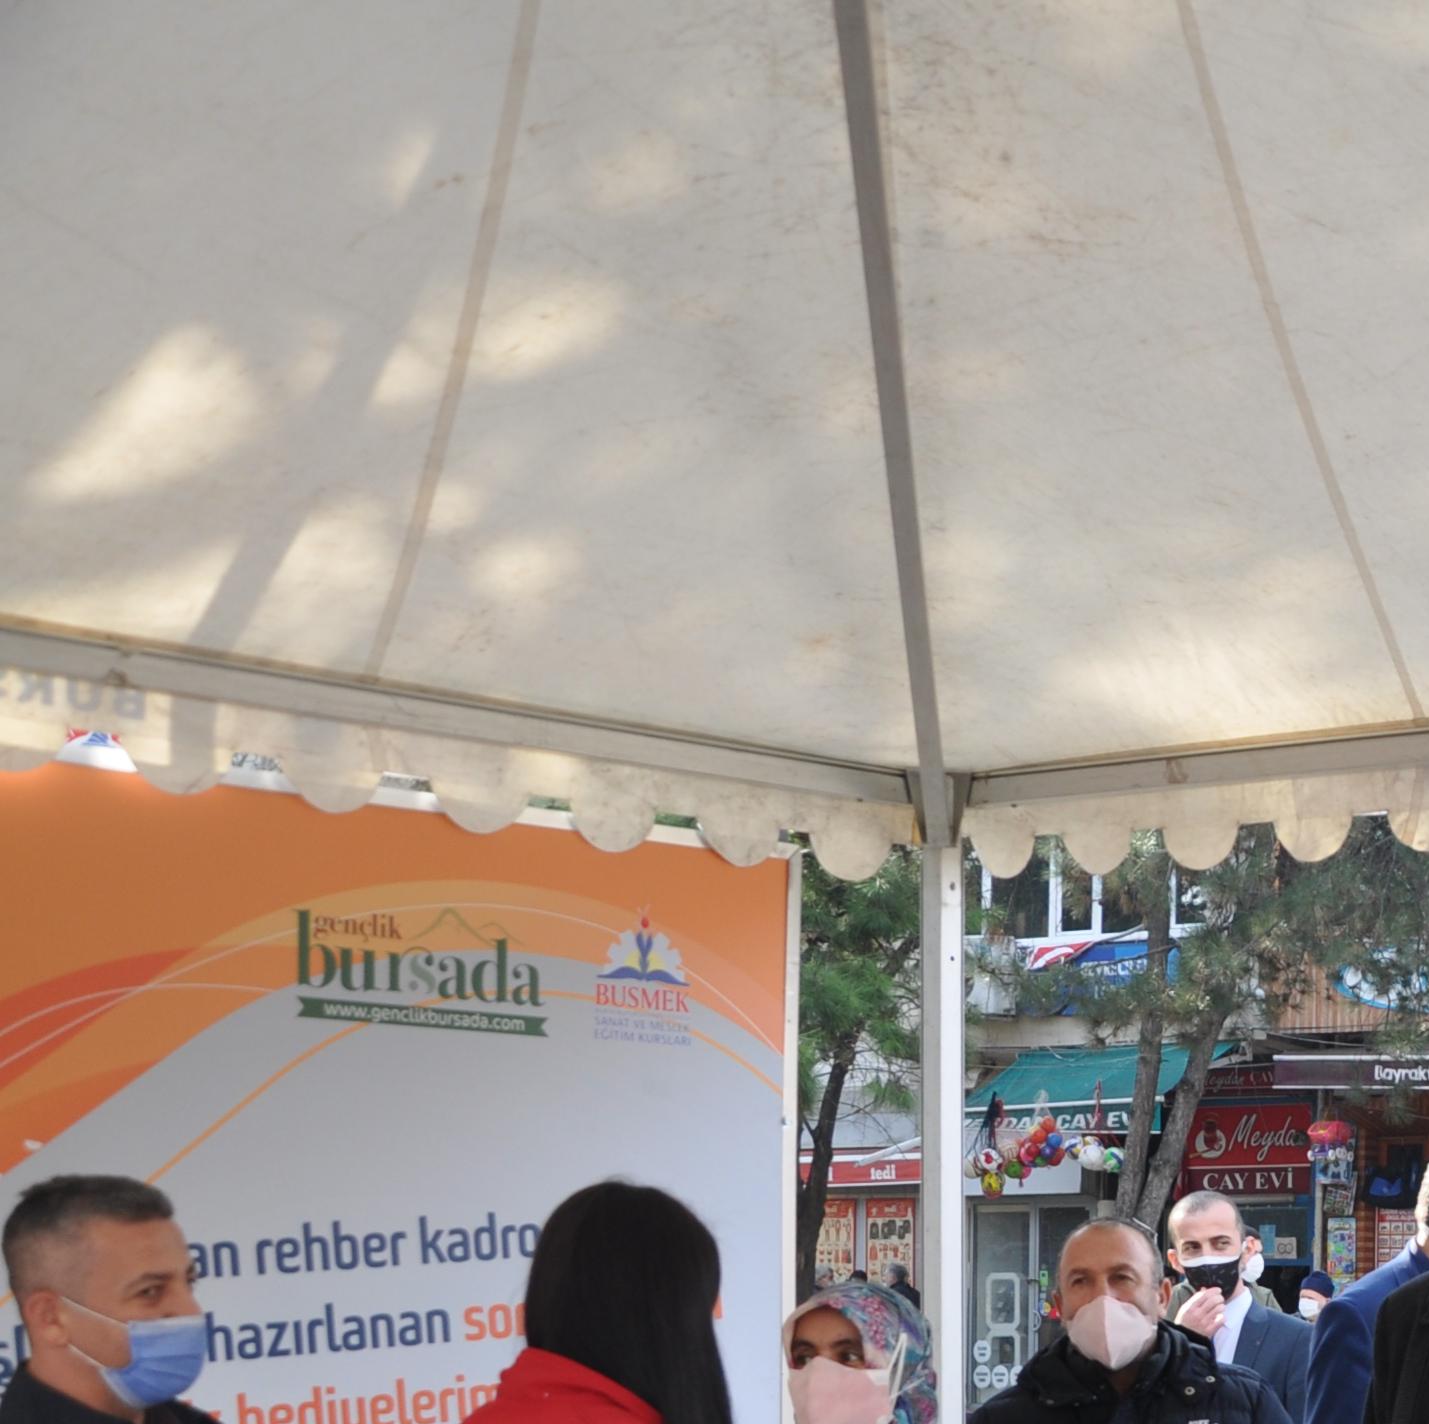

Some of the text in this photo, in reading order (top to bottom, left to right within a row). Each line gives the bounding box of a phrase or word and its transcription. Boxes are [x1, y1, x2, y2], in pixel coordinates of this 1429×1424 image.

[312, 913, 403, 942] gençlik
[293, 908, 547, 1008] bursada
[595, 983, 690, 1013] BUSMEK
[323, 1002, 526, 1032] www.genclikbursada.com
[1228, 1113, 1301, 1162] Meyda
[869, 1163, 897, 1181] tedi
[1255, 1167, 1293, 1189] EVİ
[255, 1221, 407, 1276] rehber
[420, 1215, 542, 1265] kadro
[204, 1302, 527, 1362] hazırlanan sor
